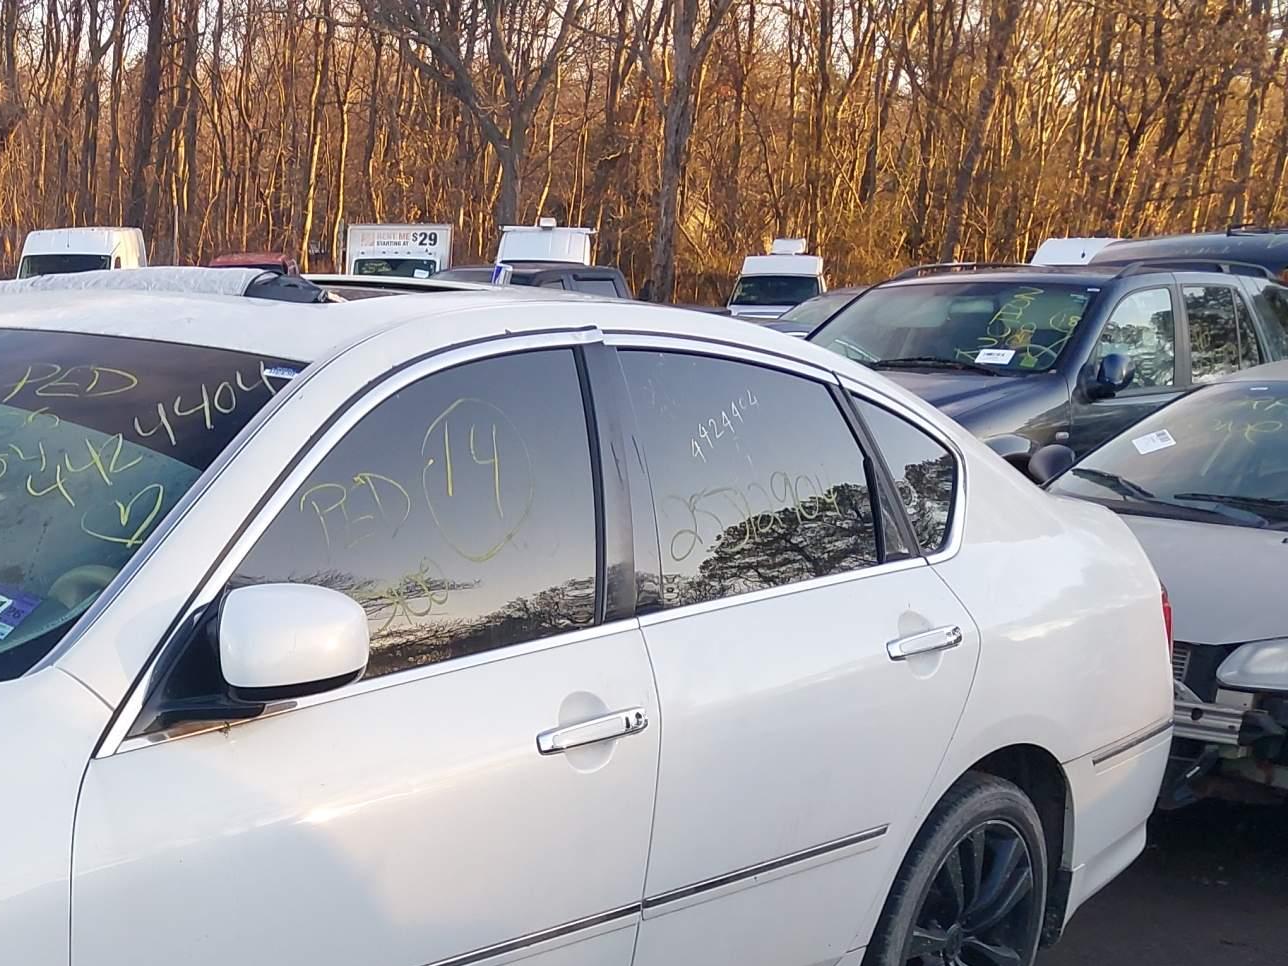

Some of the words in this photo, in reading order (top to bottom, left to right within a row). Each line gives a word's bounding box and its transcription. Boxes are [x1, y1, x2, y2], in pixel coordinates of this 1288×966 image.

[412, 231, 438, 247] $29
[2, 362, 139, 402] PED
[443, 418, 505, 521] 14
